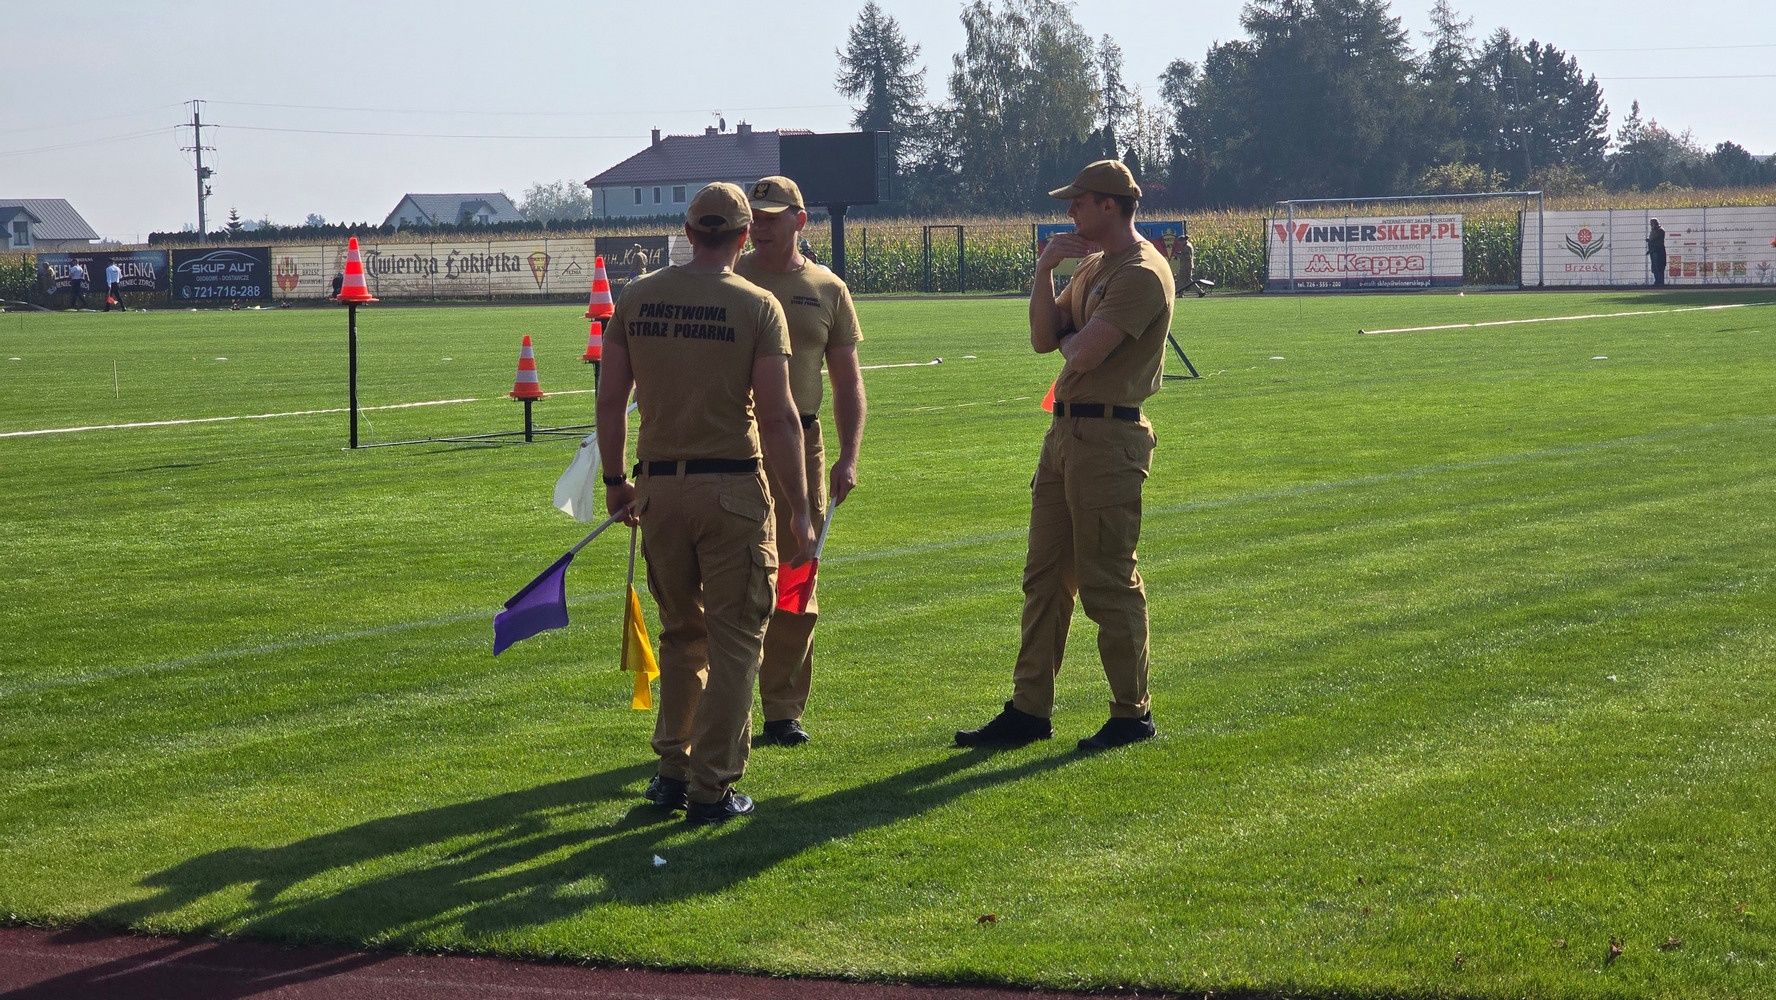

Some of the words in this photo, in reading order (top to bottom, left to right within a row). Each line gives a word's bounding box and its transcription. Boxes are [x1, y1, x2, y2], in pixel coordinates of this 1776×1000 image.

[116, 262, 156, 280] ELENKA
[192, 263, 225, 273] SKUP
[229, 262, 254, 272] AUT
[366, 250, 439, 279] Twierdza
[1337, 253, 1424, 275] Kappa
[1565, 264, 1605, 272] Brześć
[194, 285, 260, 297] 721-716-288
[639, 301, 727, 322] PAŃSTWOWA
